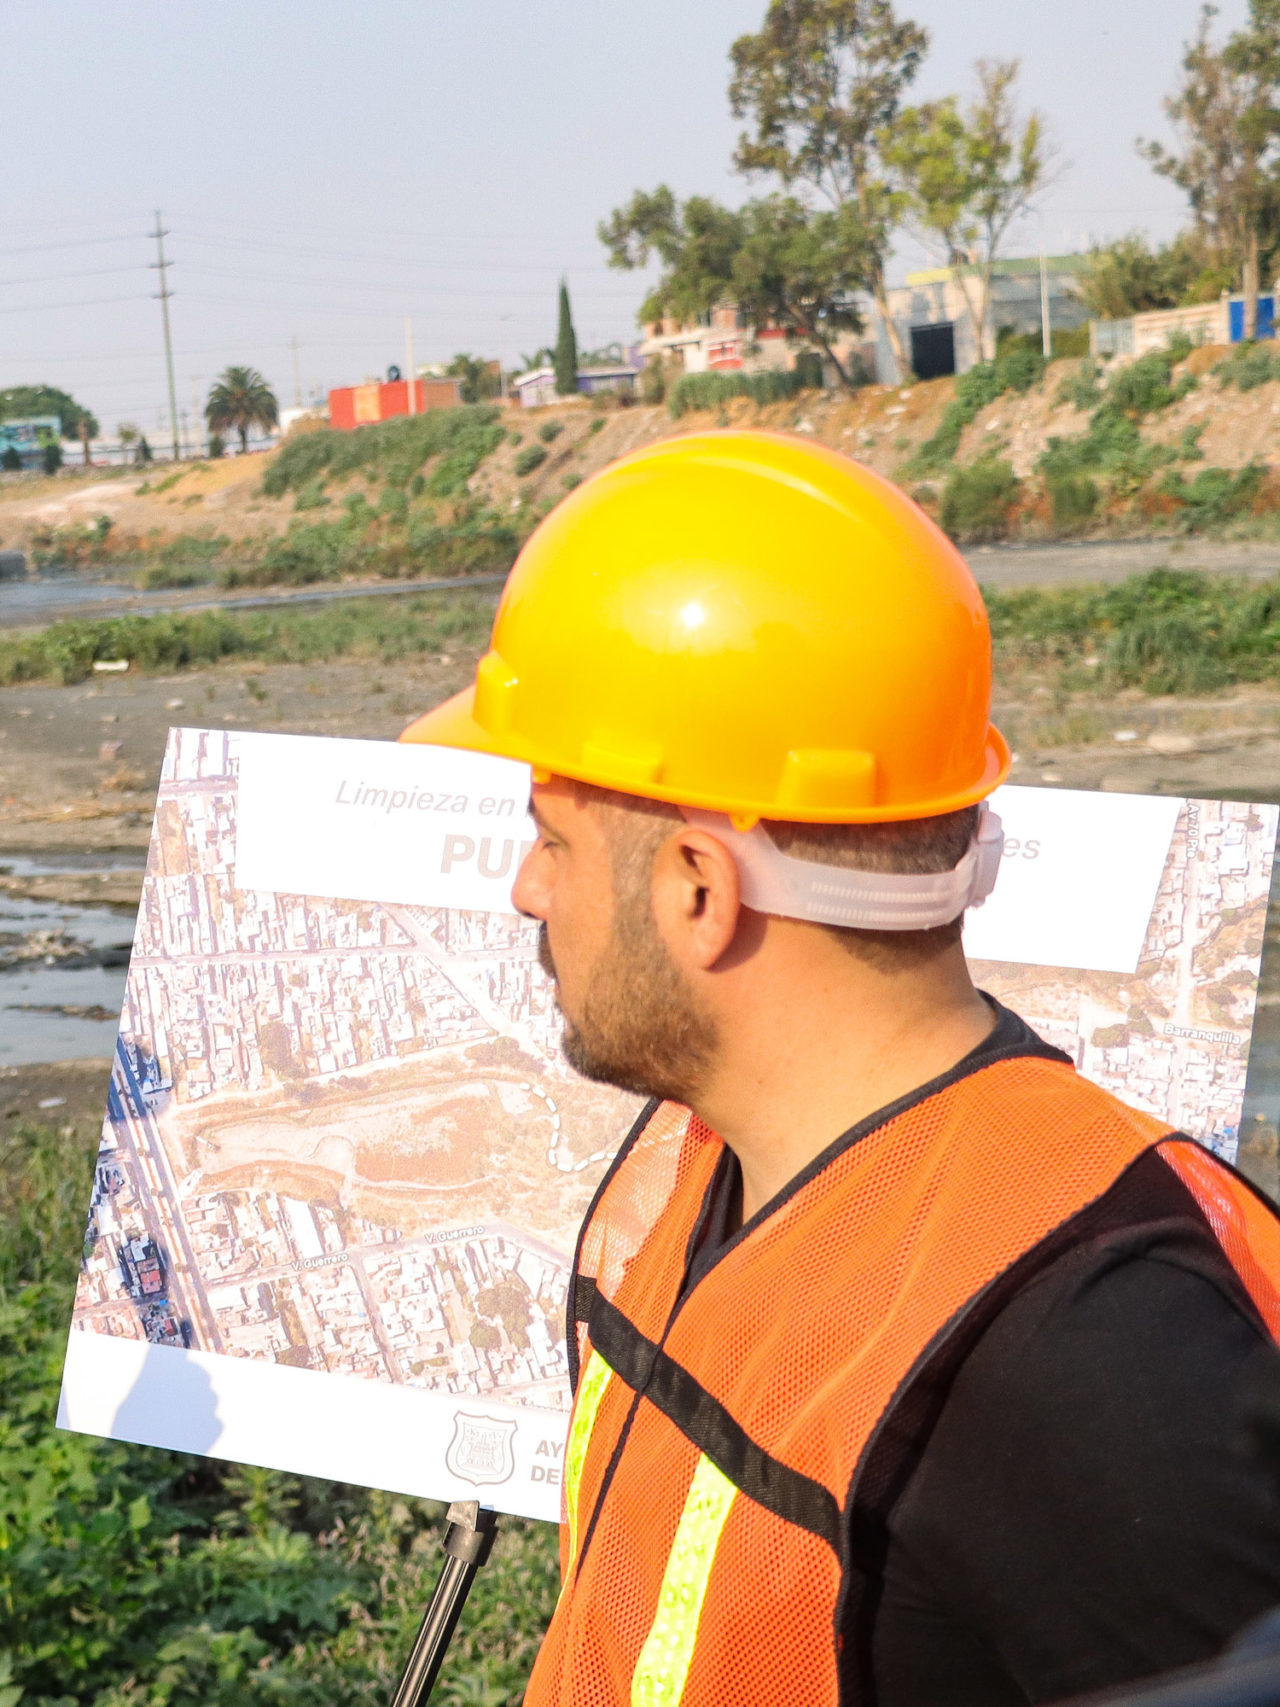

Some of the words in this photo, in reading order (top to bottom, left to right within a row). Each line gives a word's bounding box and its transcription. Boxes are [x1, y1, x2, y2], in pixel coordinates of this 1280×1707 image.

[334, 779, 469, 815] Limpieza
[477, 795, 516, 818] en
[1001, 836, 1042, 860] es
[1187, 821, 1200, 838] 70
[1186, 838, 1200, 860] Pte
[1163, 1022, 1241, 1045] Barranquilla
[436, 1225, 485, 1242] Guerrero
[303, 1252, 349, 1269] Guerrero
[534, 1439, 564, 1459] AY
[530, 1465, 561, 1486] DE
